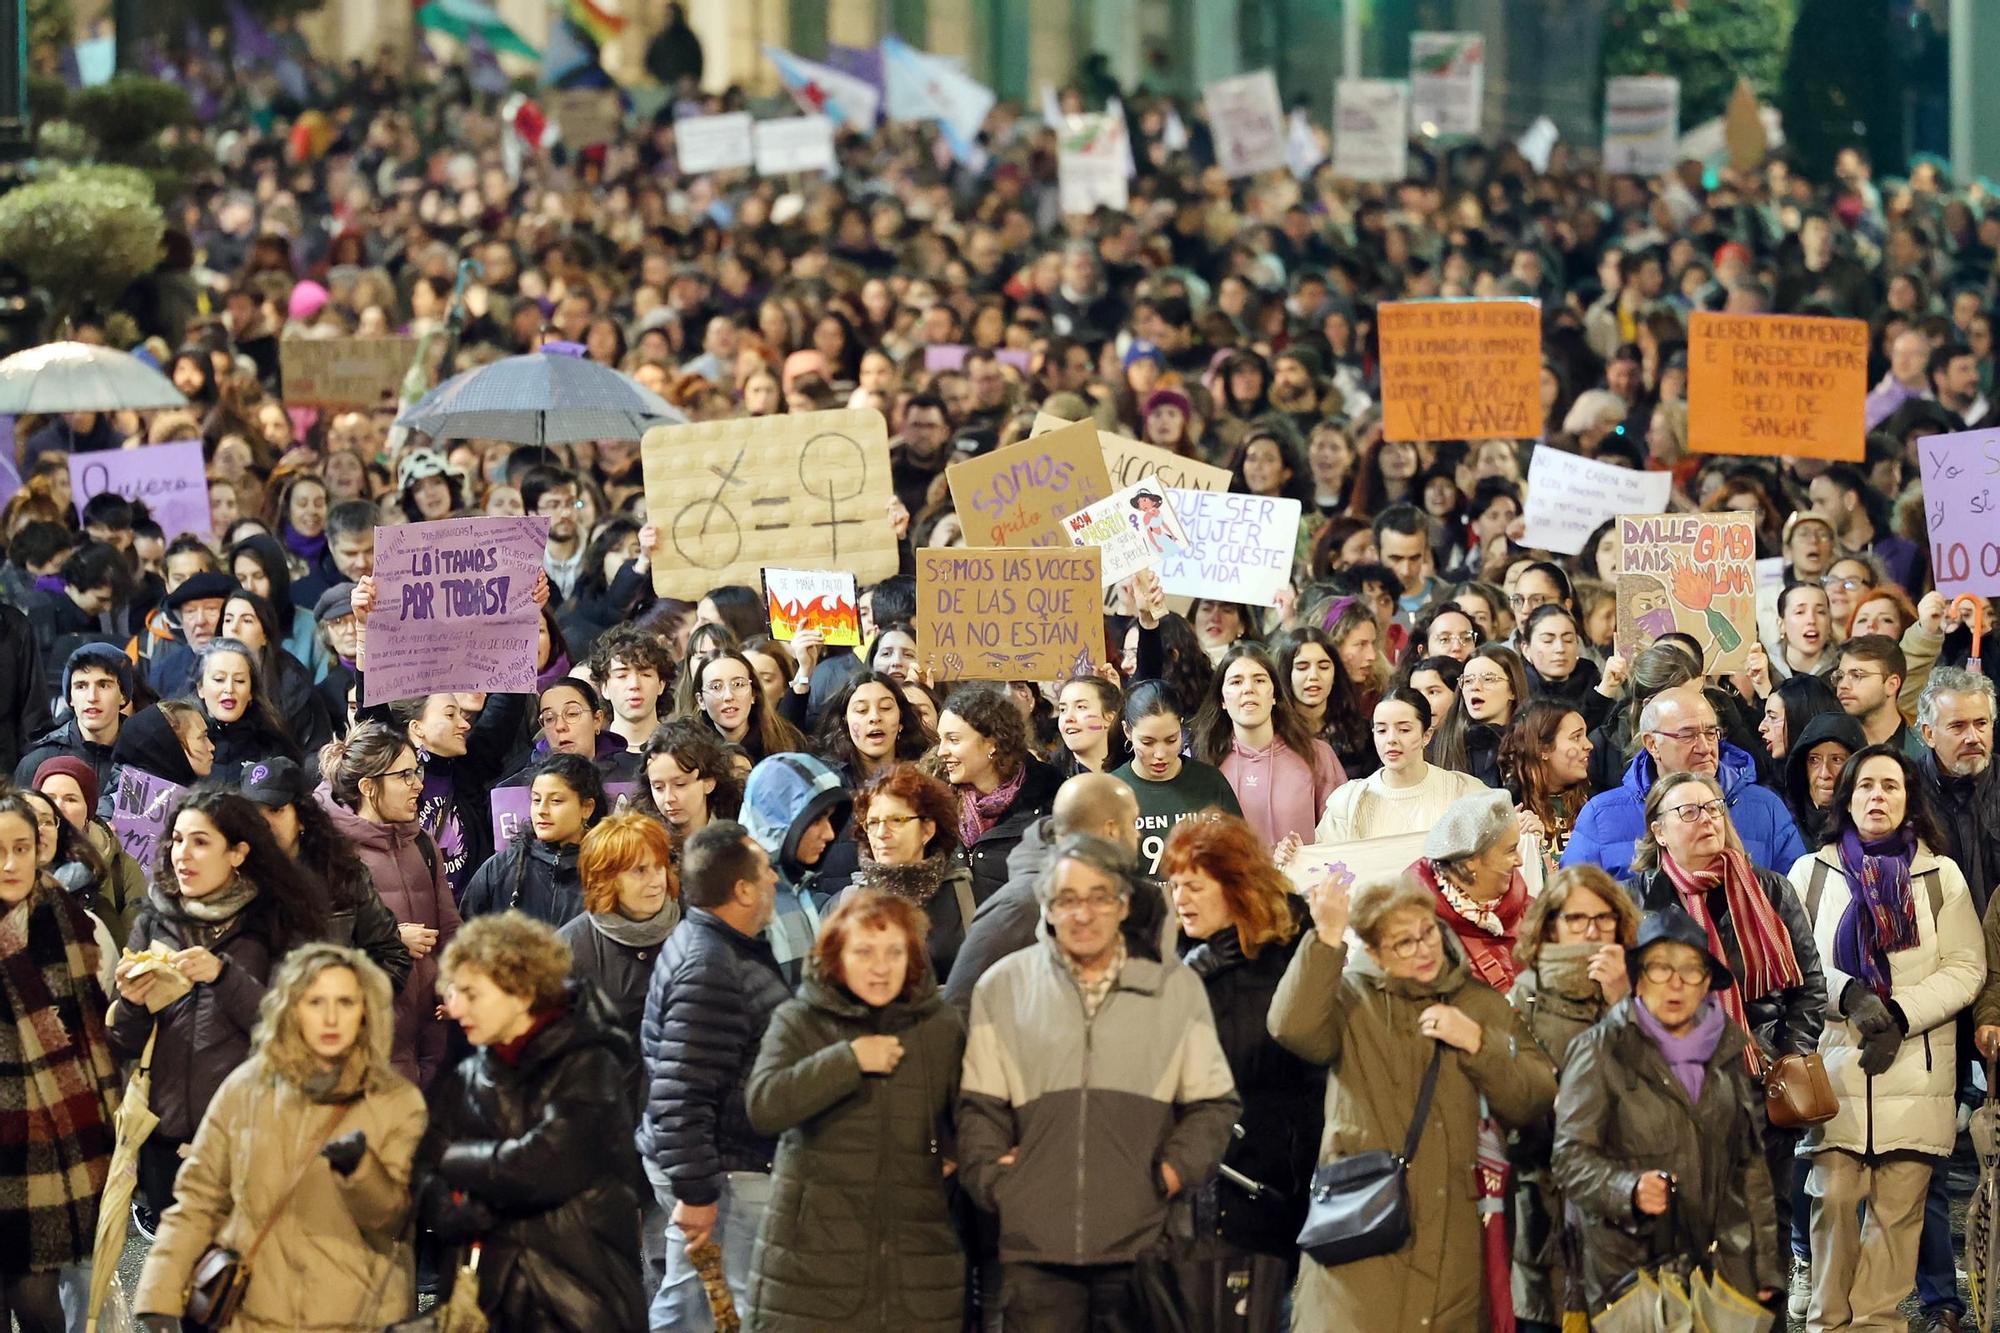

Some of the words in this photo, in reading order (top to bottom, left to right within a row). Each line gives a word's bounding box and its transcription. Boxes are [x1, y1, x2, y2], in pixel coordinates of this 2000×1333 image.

[1704, 341, 1718, 364] E
[1731, 343, 1810, 367] PAREDES
[1731, 368, 1770, 387] NUN
[1775, 370, 1836, 392] MUNDO
[1405, 400, 1530, 438] VENGANZA
[1795, 393, 1824, 416] DE
[1740, 415, 1818, 442] SANGUE
[81, 461, 194, 499] Quiero
[971, 453, 1077, 521] SOMOS
[990, 502, 1043, 546] grito
[1225, 495, 1276, 525] SER
[1930, 500, 1945, 532] y
[1179, 516, 1263, 546] MUJER
[1622, 518, 1700, 546] DALLE
[925, 557, 996, 585] SOMOS
[1002, 557, 1033, 583] LAS
[1035, 556, 1097, 583] VOCES
[1217, 543, 1286, 571] CUESTE
[1935, 541, 1971, 584] LO
[1161, 561, 1186, 578] LA
[1199, 563, 1241, 585] VIDA
[400, 581, 435, 621] POR
[440, 575, 511, 618] TODAS!
[936, 587, 967, 615] DE
[976, 586, 1018, 616] LAS
[1026, 586, 1076, 622] QUE
[930, 621, 958, 649] YA
[966, 620, 1001, 648] NO
[1010, 615, 1080, 648] ESTÁN
[1141, 834, 1165, 876] 9
